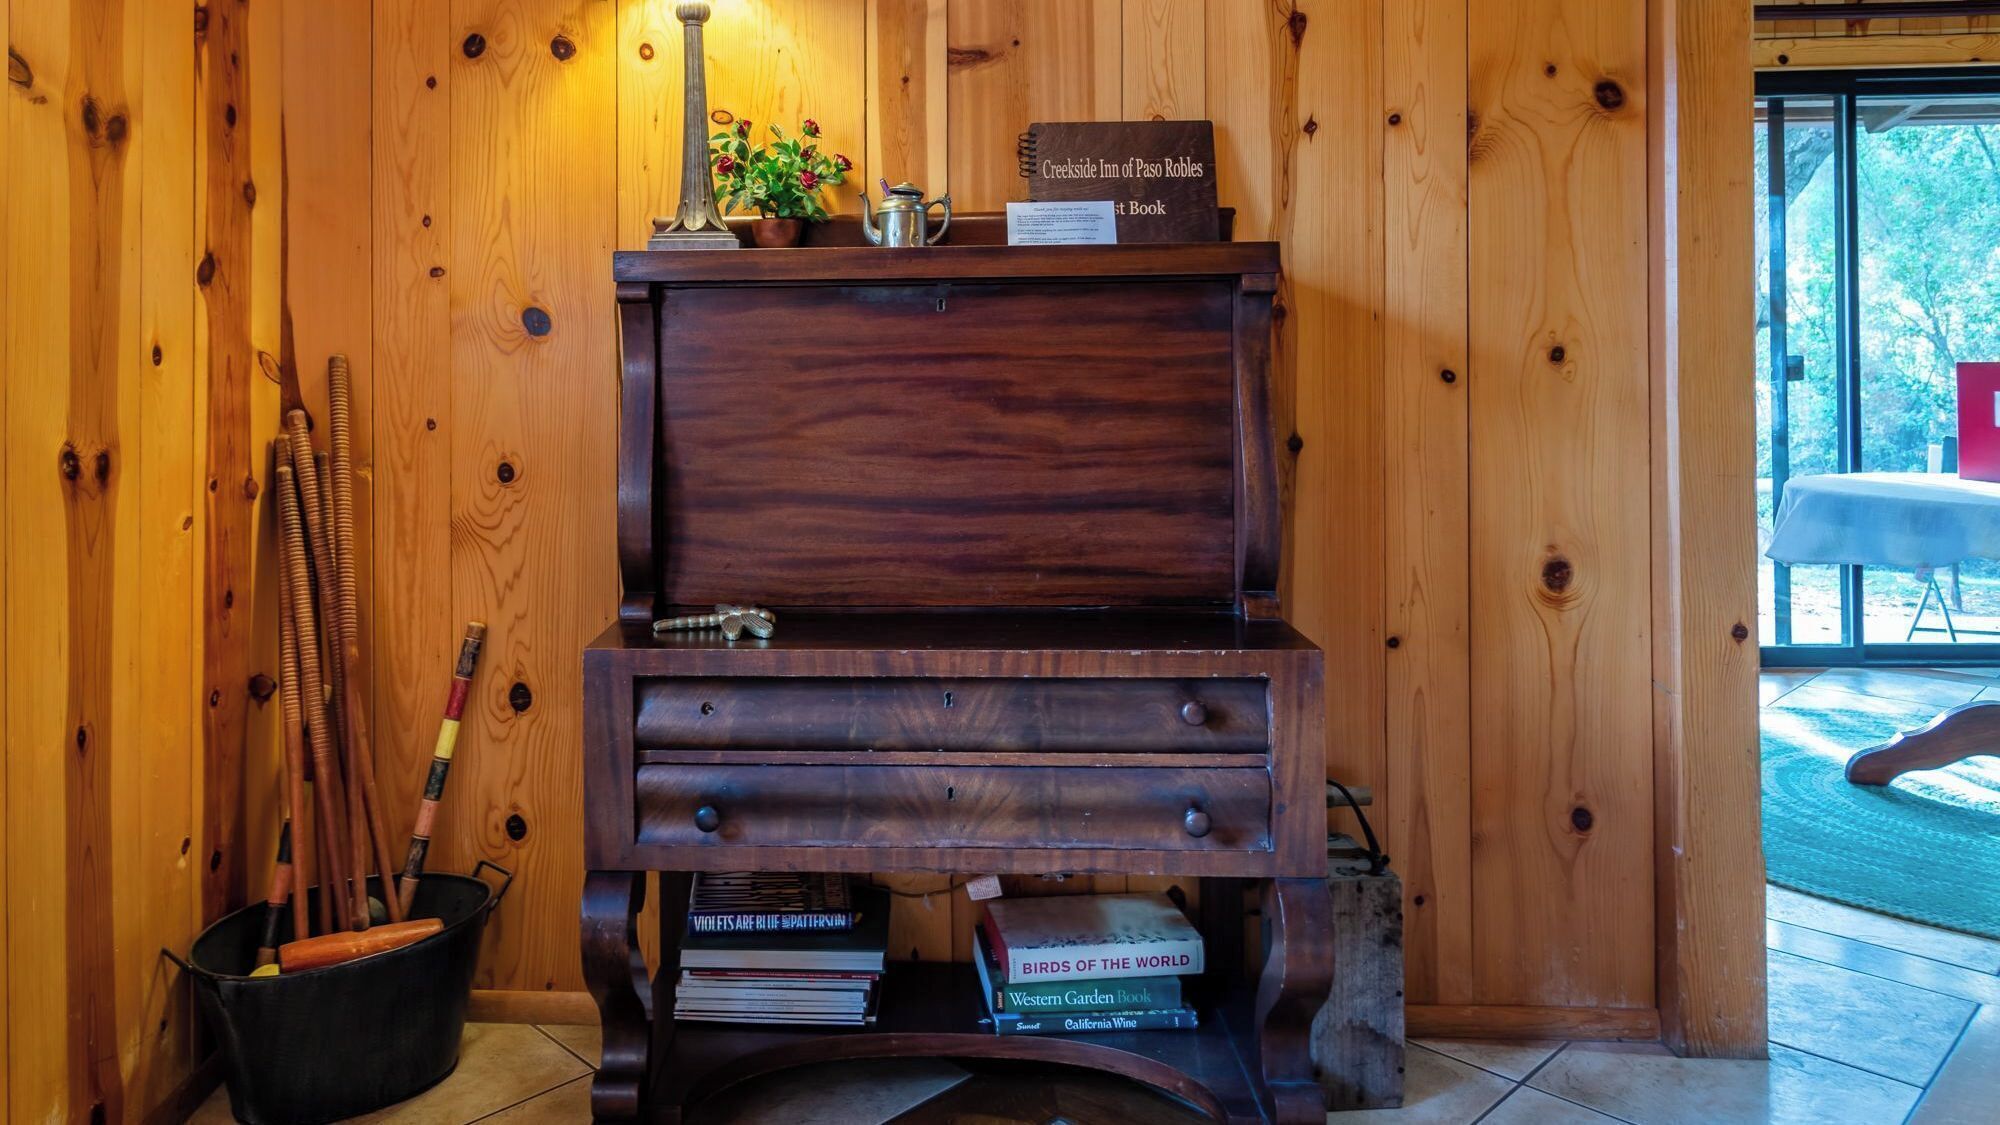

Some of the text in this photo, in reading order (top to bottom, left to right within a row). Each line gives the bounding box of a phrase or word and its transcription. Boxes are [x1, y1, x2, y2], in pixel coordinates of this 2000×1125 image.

[1042, 156, 1203, 179] Creekside Inn of Paso Robles
[1129, 200, 1166, 215] Book
[694, 914, 735, 932] VIOLETS
[735, 914, 755, 931] ARE
[756, 914, 780, 930] BLUE
[791, 913, 846, 929] PATTERSON
[1022, 959, 1071, 975] BIRDS
[1075, 958, 1096, 972] OF
[1100, 956, 1131, 970] THE
[1135, 954, 1190, 968] WORLD
[1009, 988, 1152, 1007] Western Garden Book
[1016, 1022, 1041, 1031] Sunset
[1064, 1017, 1137, 1030] California Wine
